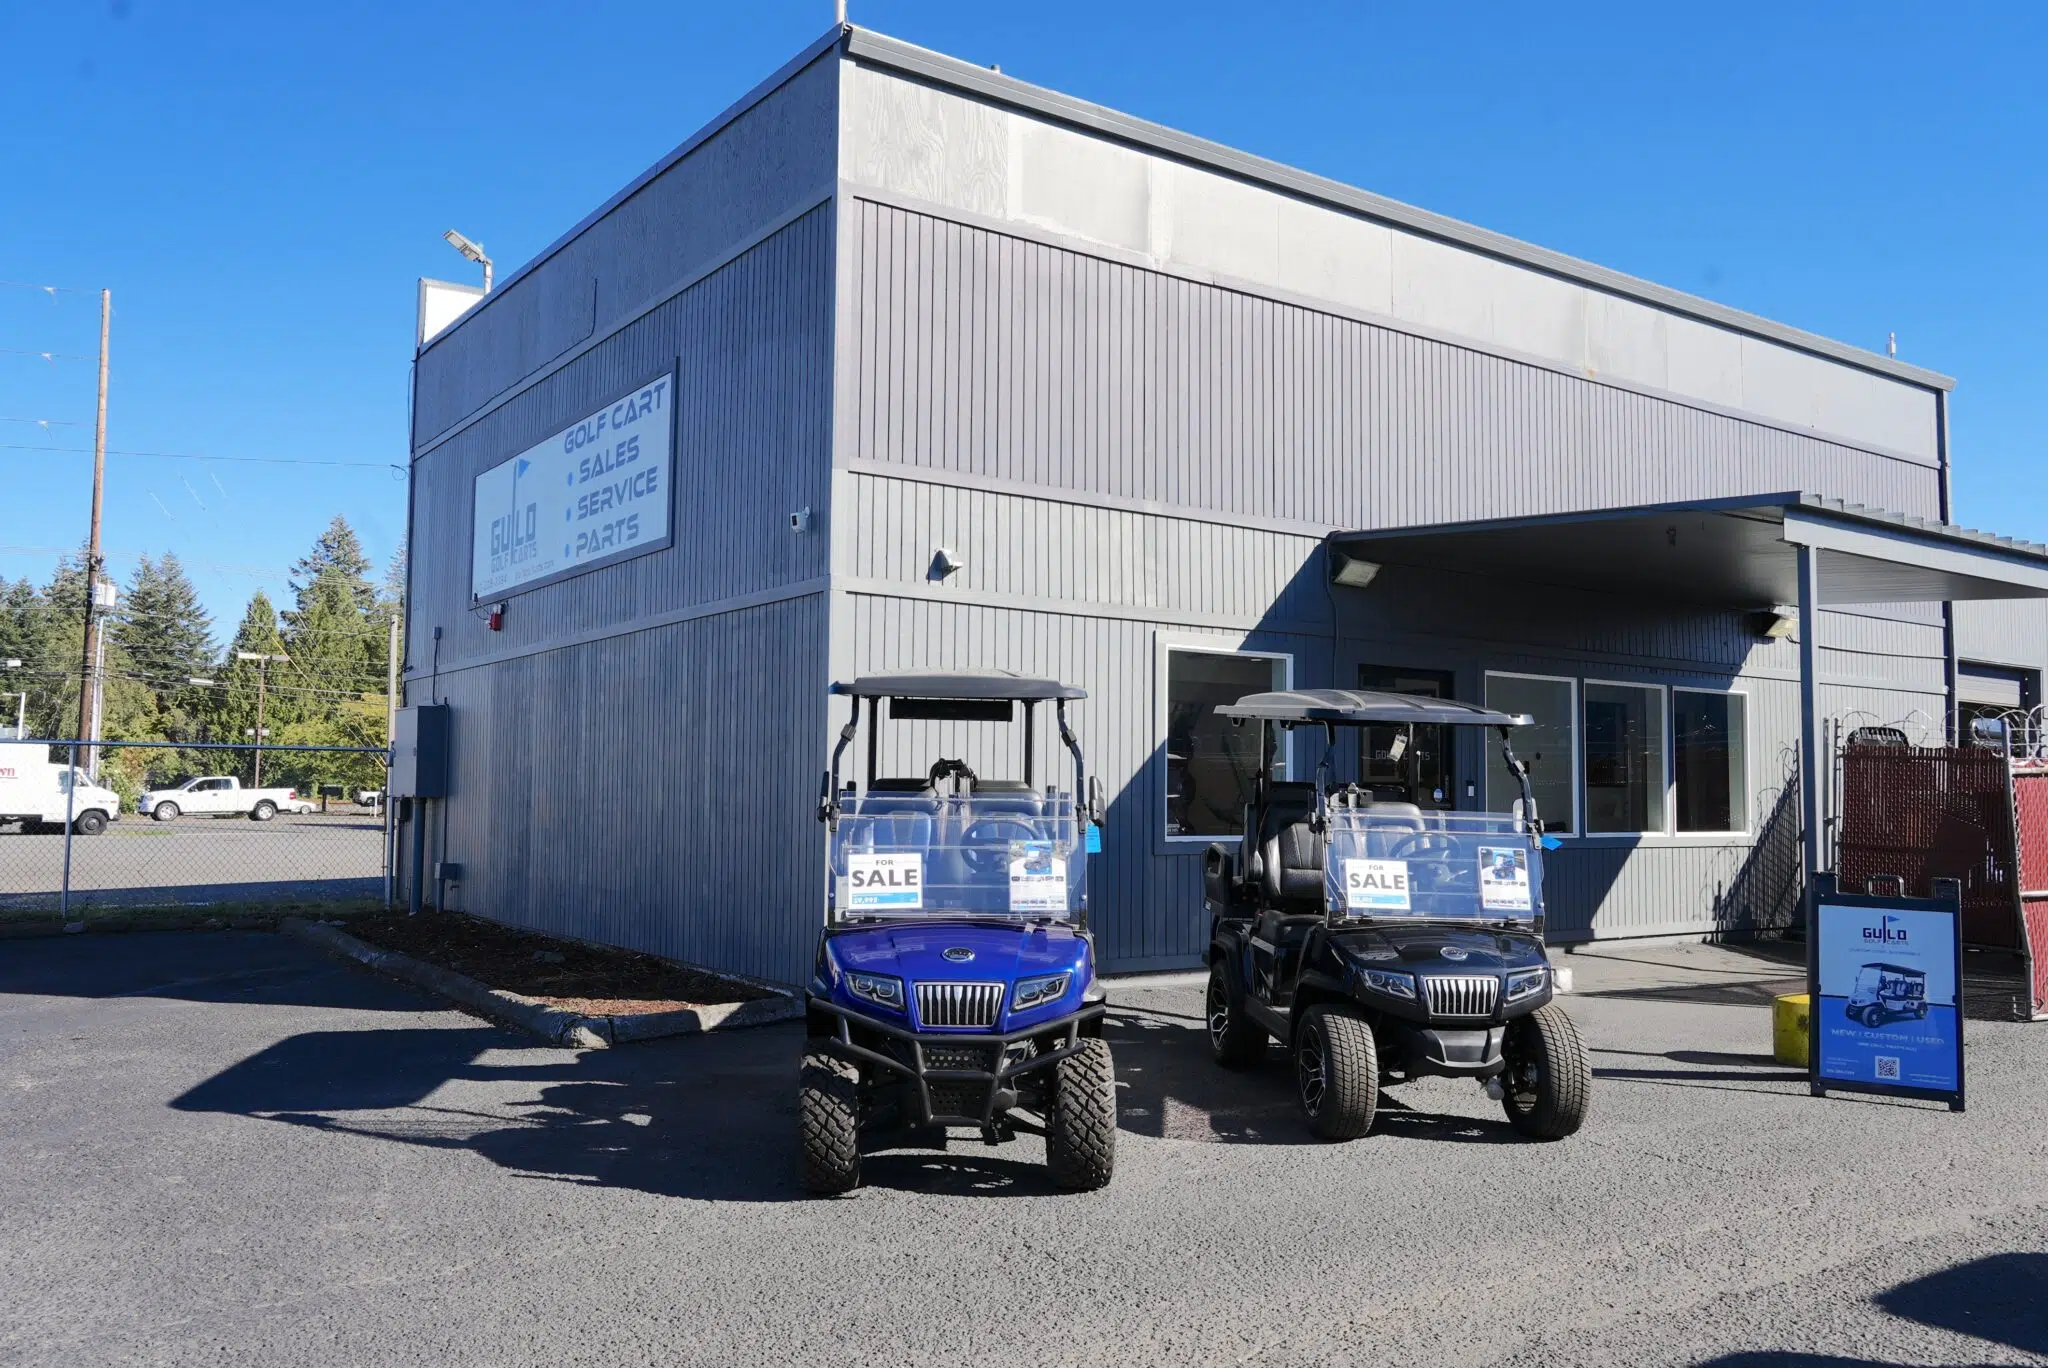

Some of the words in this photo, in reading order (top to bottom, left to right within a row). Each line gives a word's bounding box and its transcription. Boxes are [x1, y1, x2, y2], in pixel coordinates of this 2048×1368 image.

[564, 412, 607, 454] GOLF
[612, 381, 667, 430] CART
[579, 434, 640, 484] SALES
[577, 466, 658, 520] SERVICE
[576, 513, 639, 558] PARTS
[491, 551, 509, 573] GOLF
[852, 869, 918, 887] SALE
[1350, 872, 1405, 890] SALE
[1831, 1028, 1856, 1037] NEW
[1863, 1031, 1908, 1042] CUSTOM
[1916, 1036, 1945, 1045] USED
